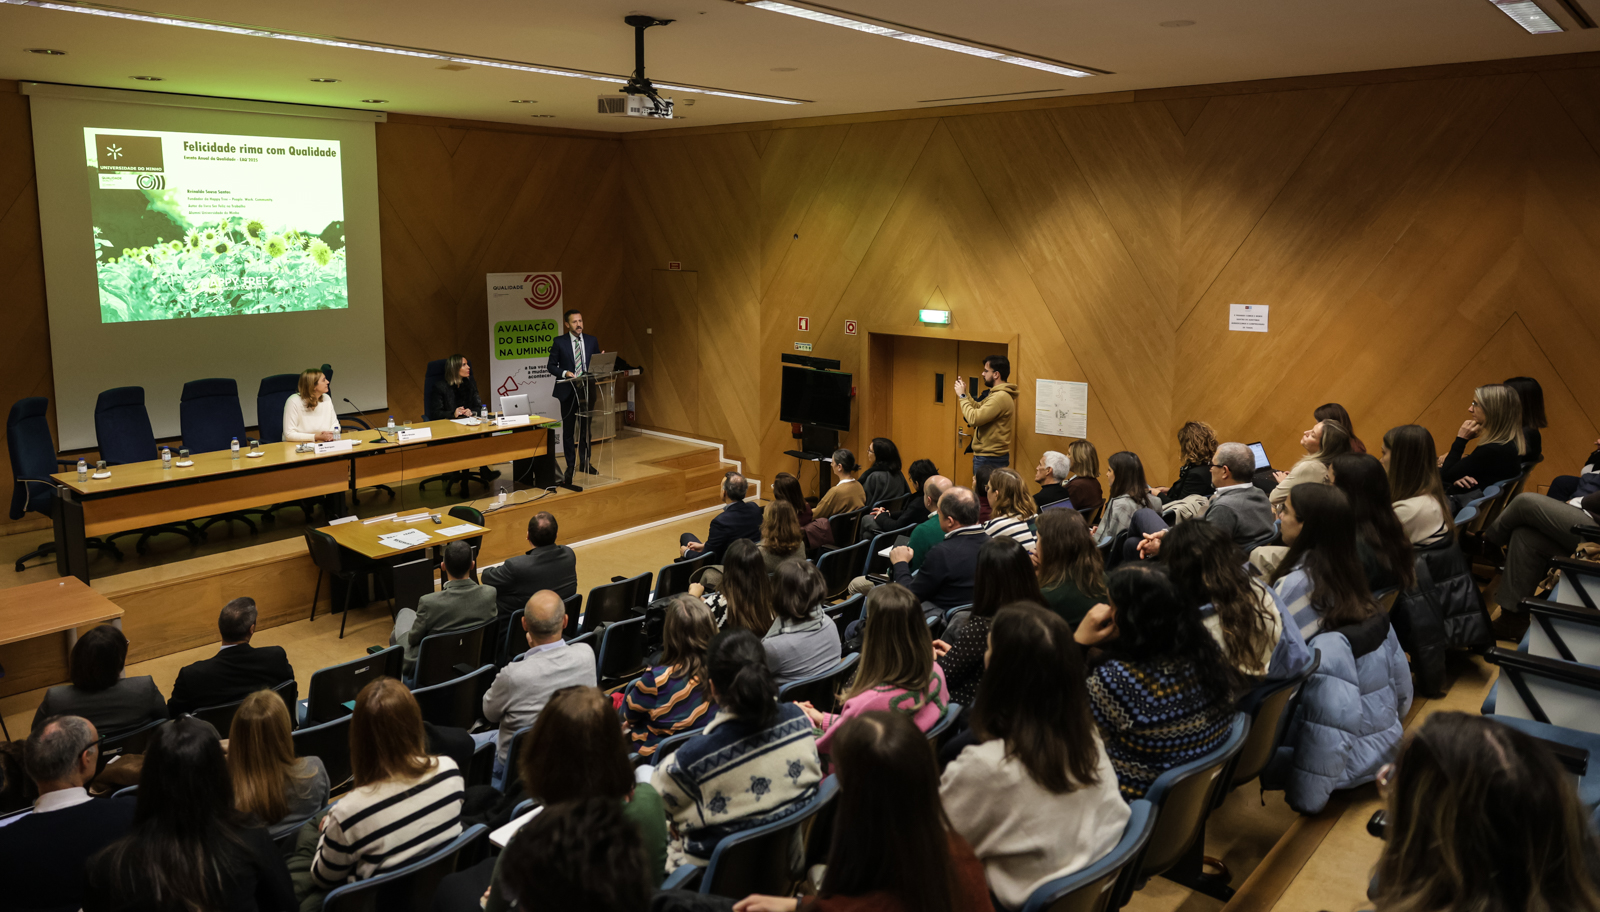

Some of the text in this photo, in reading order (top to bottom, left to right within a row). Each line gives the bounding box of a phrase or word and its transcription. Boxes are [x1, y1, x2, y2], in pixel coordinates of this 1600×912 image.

[183, 141, 336, 157] Felicidade rima com Qualidade
[498, 321, 555, 333] AVALIAÇÃO
[499, 335, 552, 344] DO ENSINO
